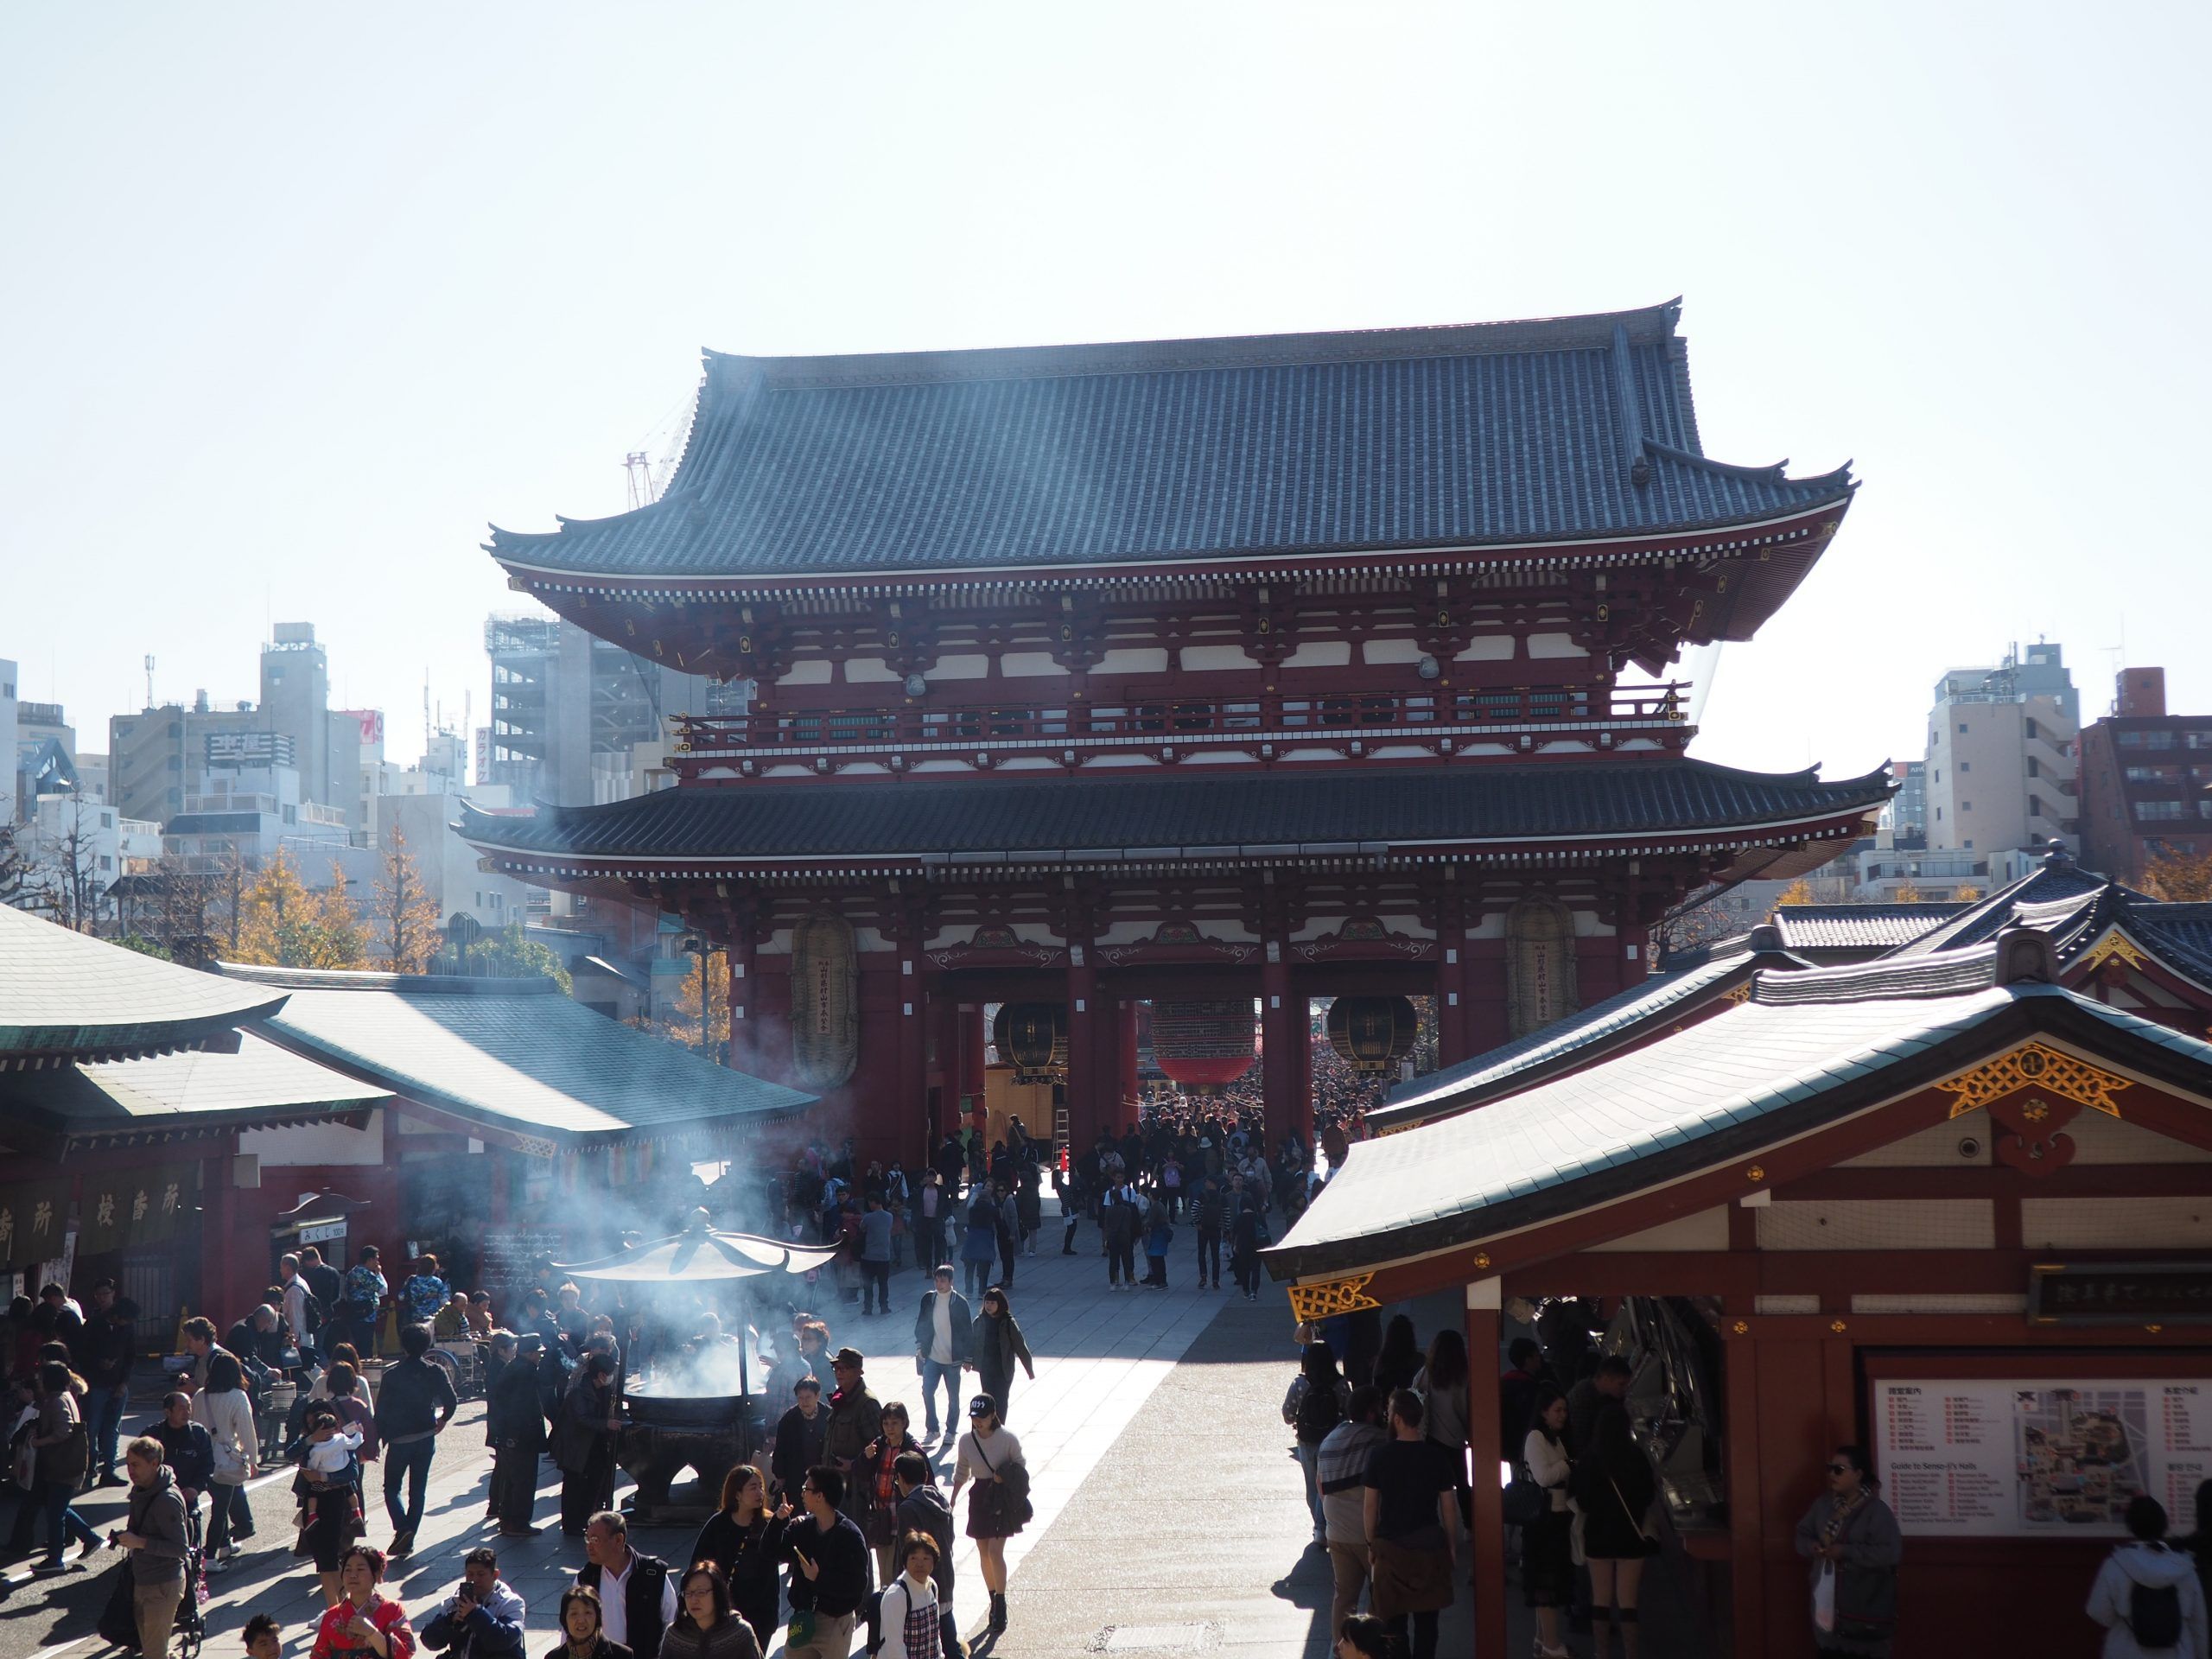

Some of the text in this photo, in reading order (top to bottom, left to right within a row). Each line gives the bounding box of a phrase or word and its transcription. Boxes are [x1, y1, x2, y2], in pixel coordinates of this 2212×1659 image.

[477, 728, 486, 782] カラオケ
[304, 1226, 330, 1242] みくじ
